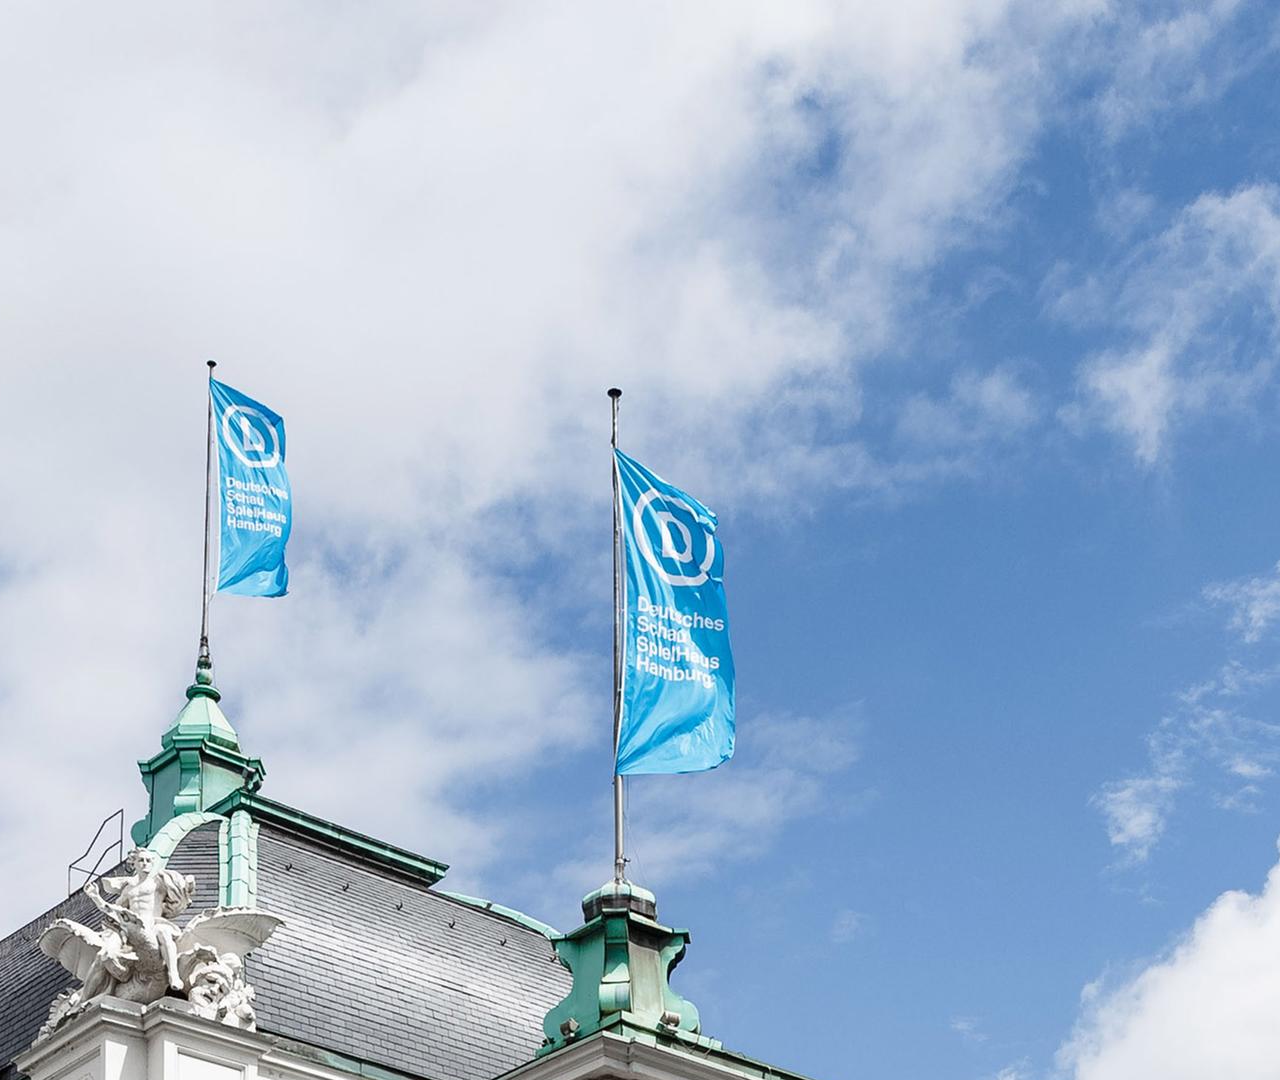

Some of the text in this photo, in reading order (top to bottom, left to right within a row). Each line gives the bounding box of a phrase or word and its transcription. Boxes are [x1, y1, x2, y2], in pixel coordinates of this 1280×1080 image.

[226, 477, 288, 500] Deutsches
[226, 490, 265, 506] Schau
[226, 502, 287, 524] SpielHaus
[227, 516, 283, 537] Hamburg
[637, 596, 724, 631] Deutsches
[636, 616, 688, 643] Schau
[636, 636, 720, 671] SpielHaus
[636, 656, 714, 689] Hamburg
